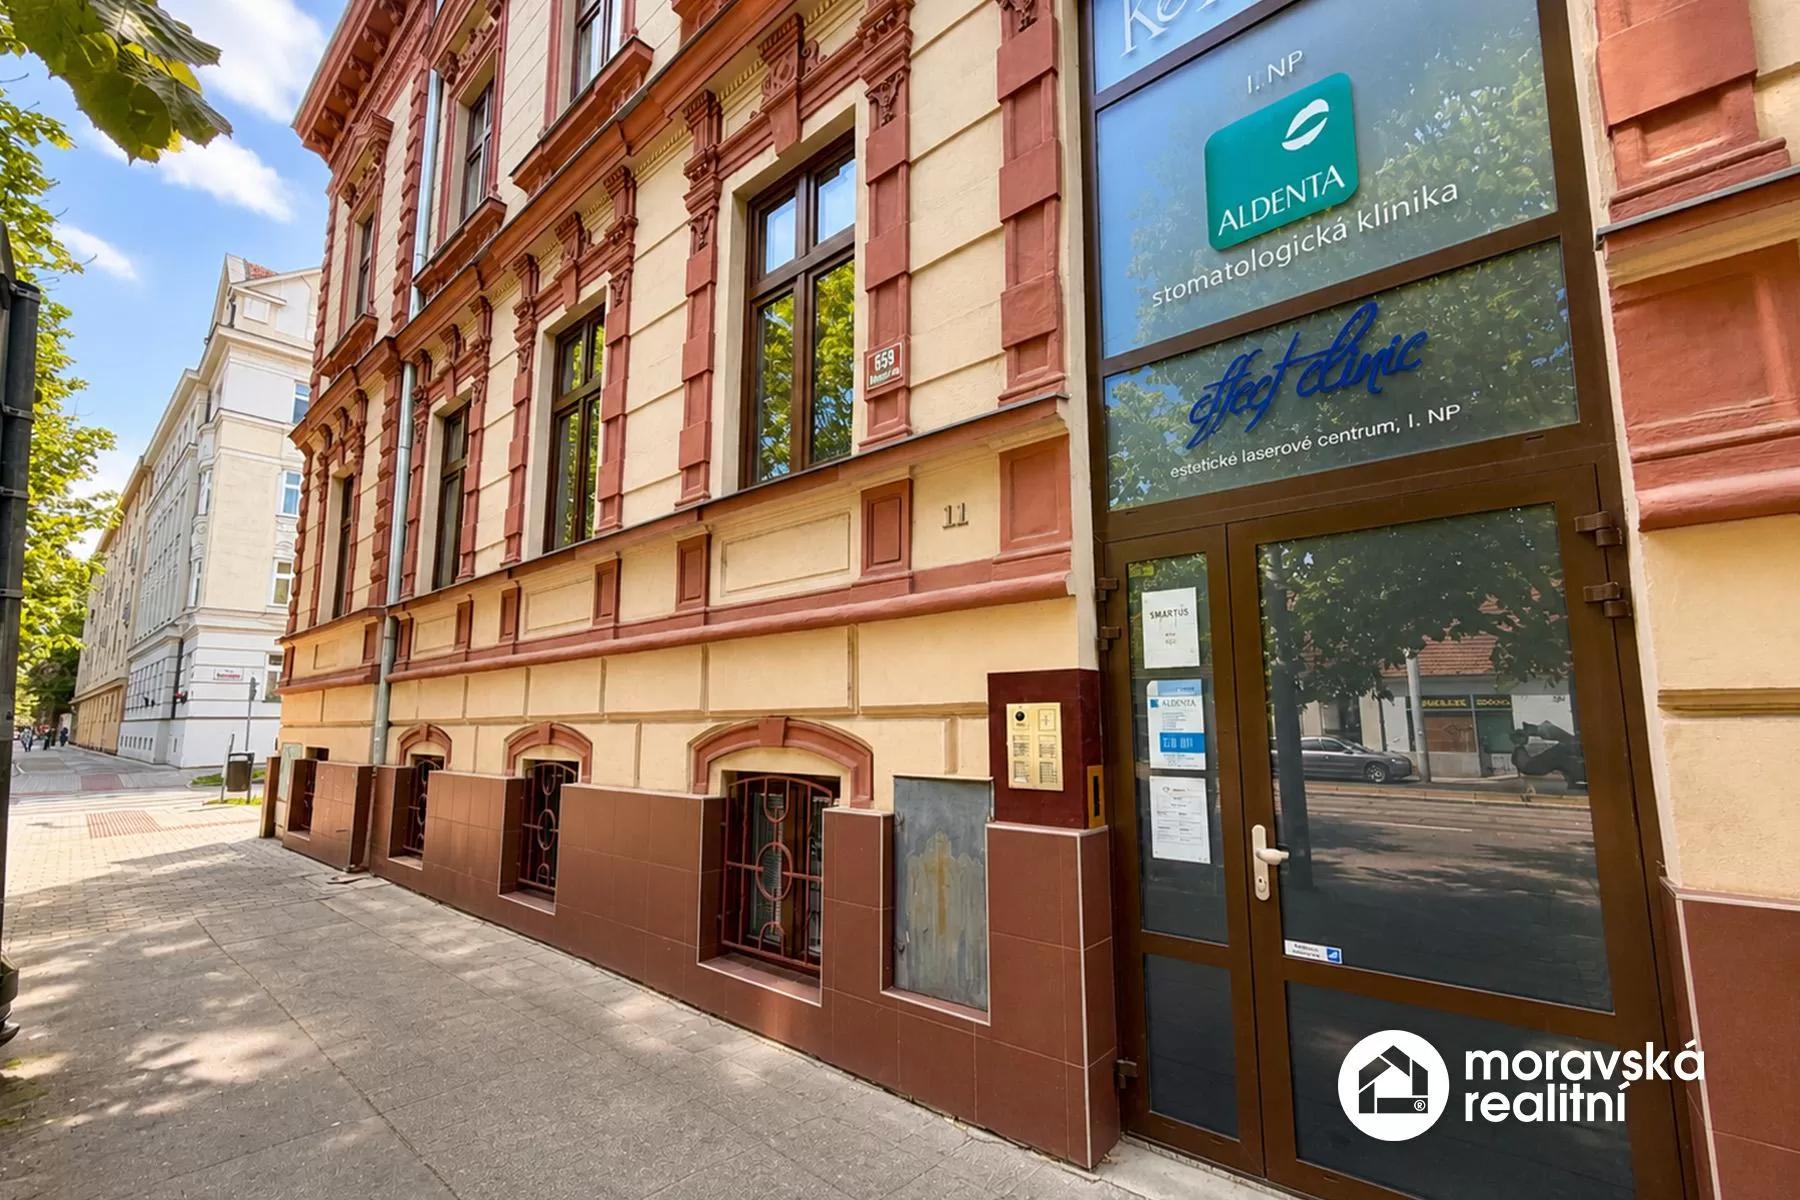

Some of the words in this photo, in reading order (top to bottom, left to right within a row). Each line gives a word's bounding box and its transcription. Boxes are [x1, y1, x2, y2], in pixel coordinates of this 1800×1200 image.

[1267, 50, 1304, 84] NP
[1217, 164, 1346, 236] ALDENTA
[1151, 217, 1348, 308] stomatologická
[1357, 182, 1459, 233] klinika
[874, 349, 895, 371] 659
[1170, 454, 1238, 479] estetické
[1241, 434, 1313, 464] laserové
[1317, 417, 1401, 448] centrum,
[1407, 413, 1421, 429] I.
[1427, 404, 1461, 424] NP
[942, 502, 969, 530] 11
